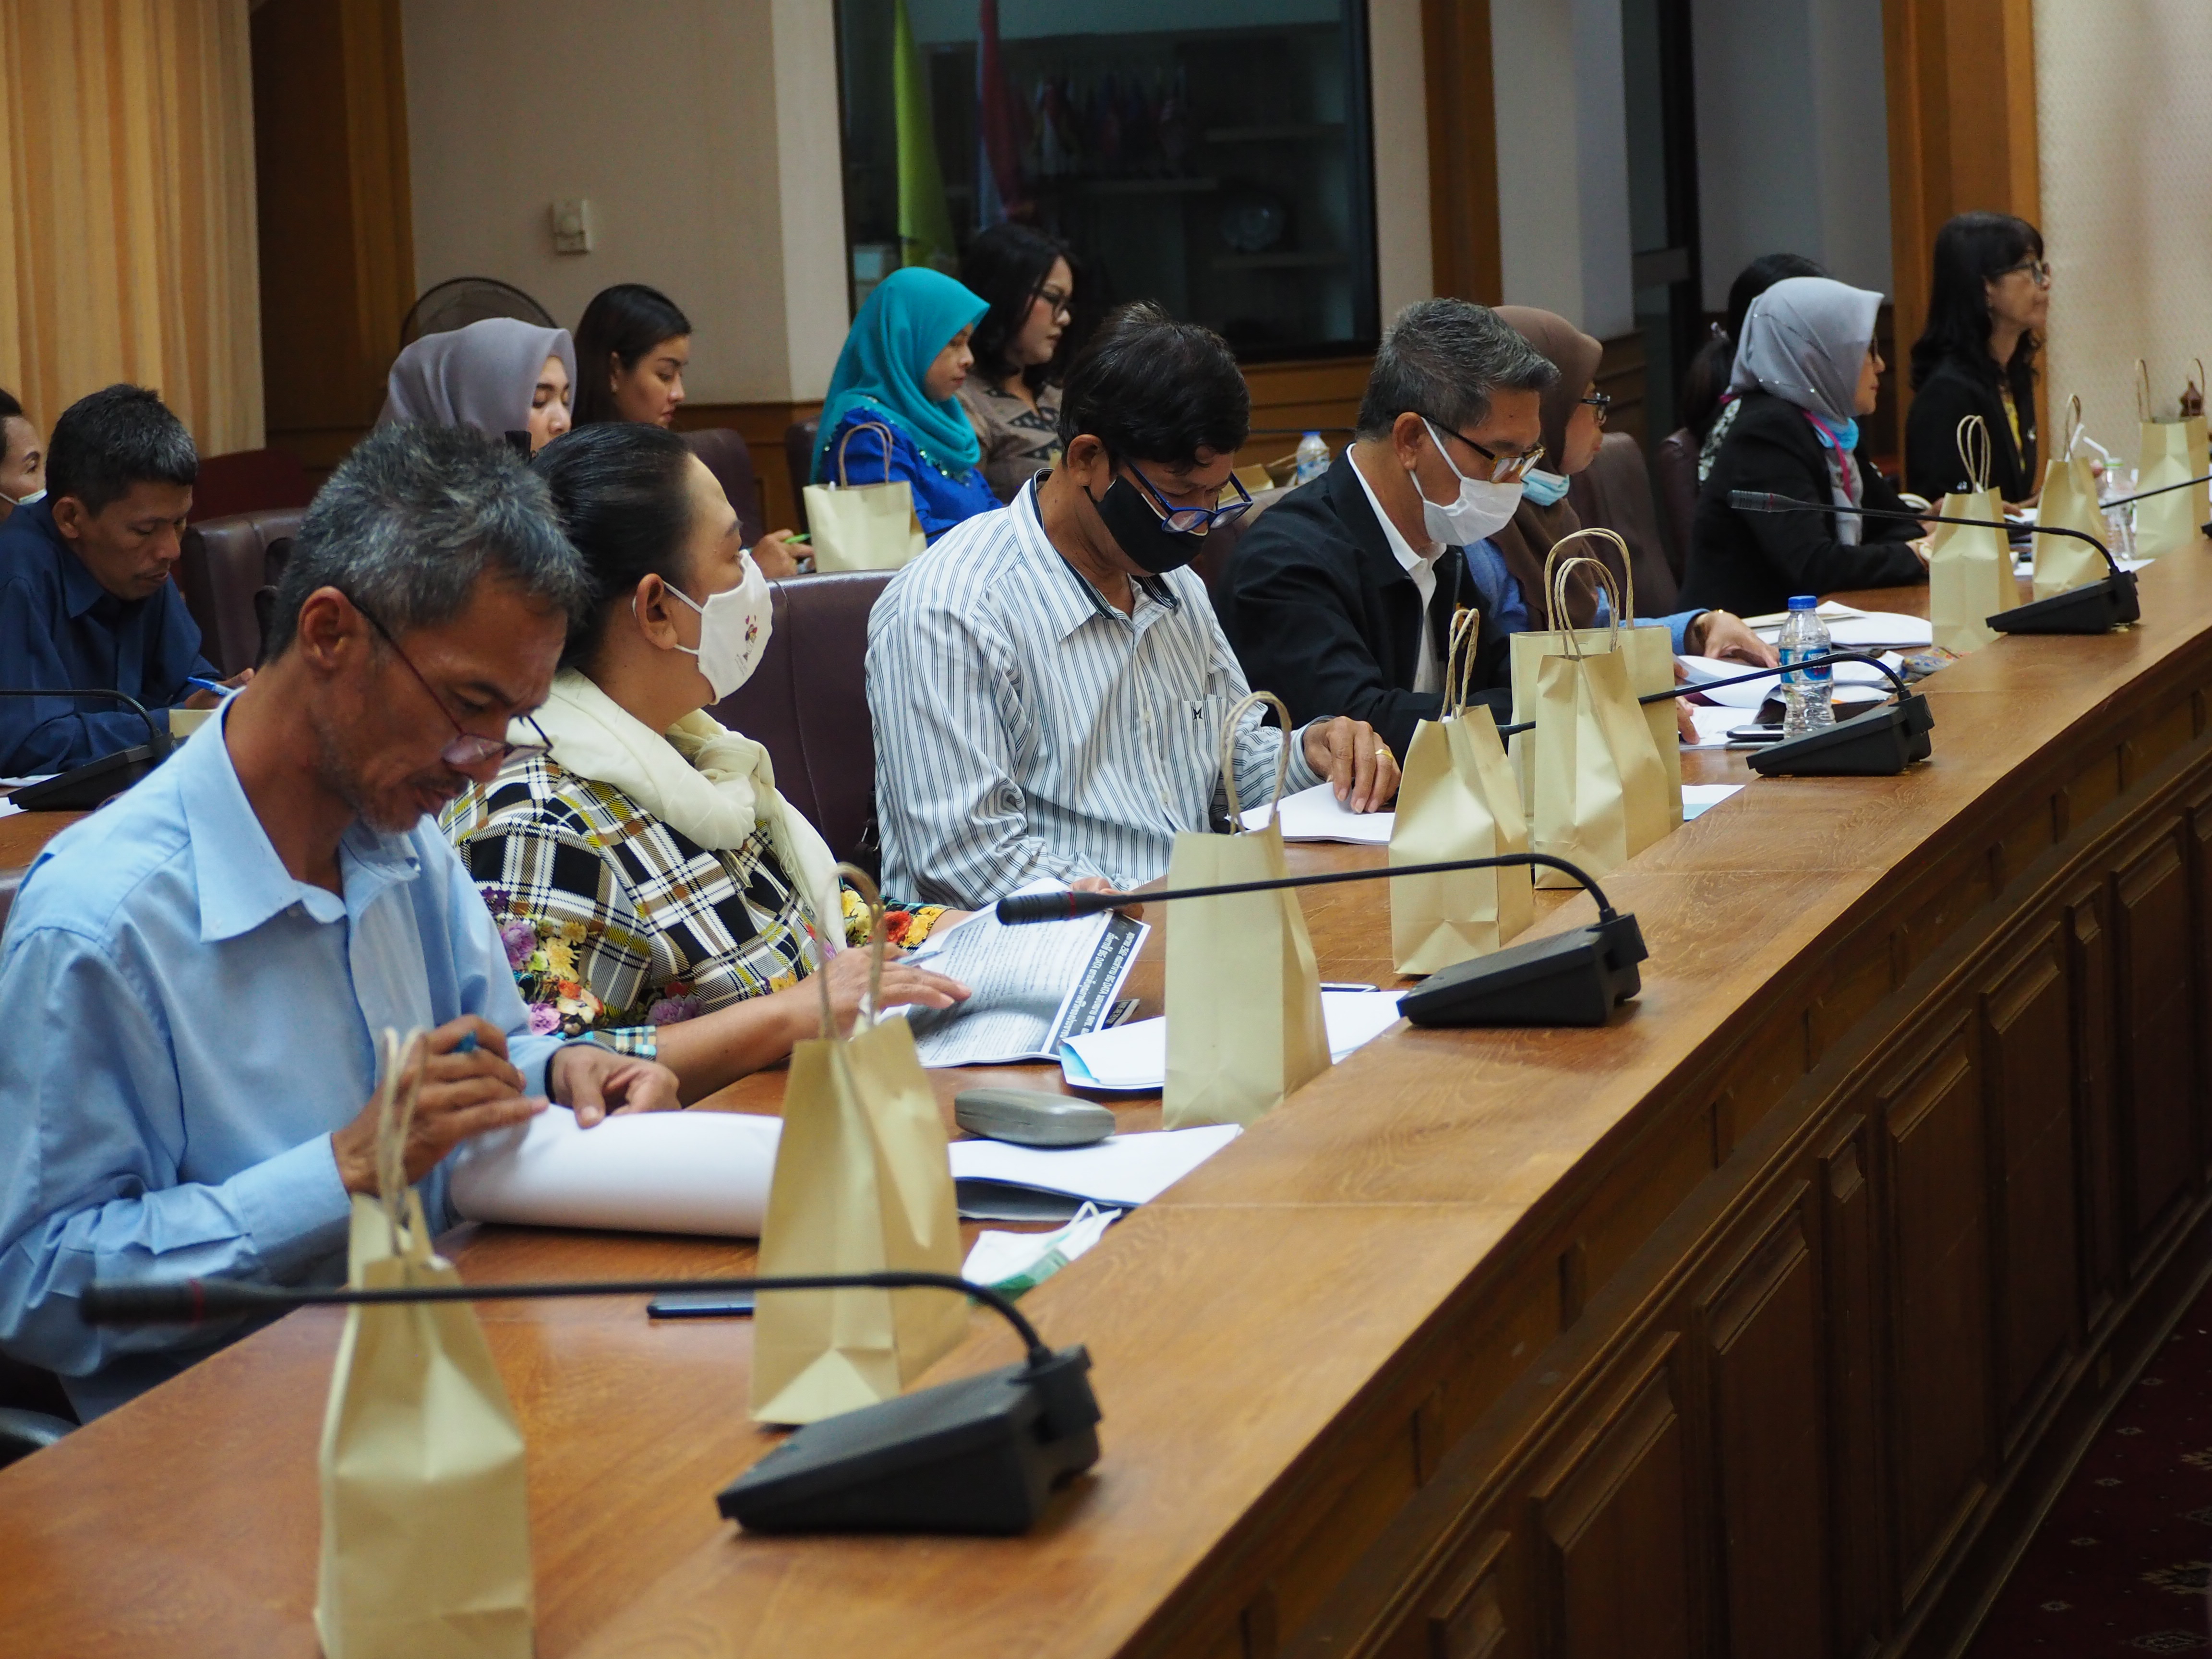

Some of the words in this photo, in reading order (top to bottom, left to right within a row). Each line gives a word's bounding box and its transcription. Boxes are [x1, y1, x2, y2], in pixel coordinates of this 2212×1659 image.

[1096, 949, 1108, 958] BIG
[1091, 956, 1104, 969] DATA
[1104, 974, 1116, 983] BIG
[1098, 981, 1112, 994] DATA
